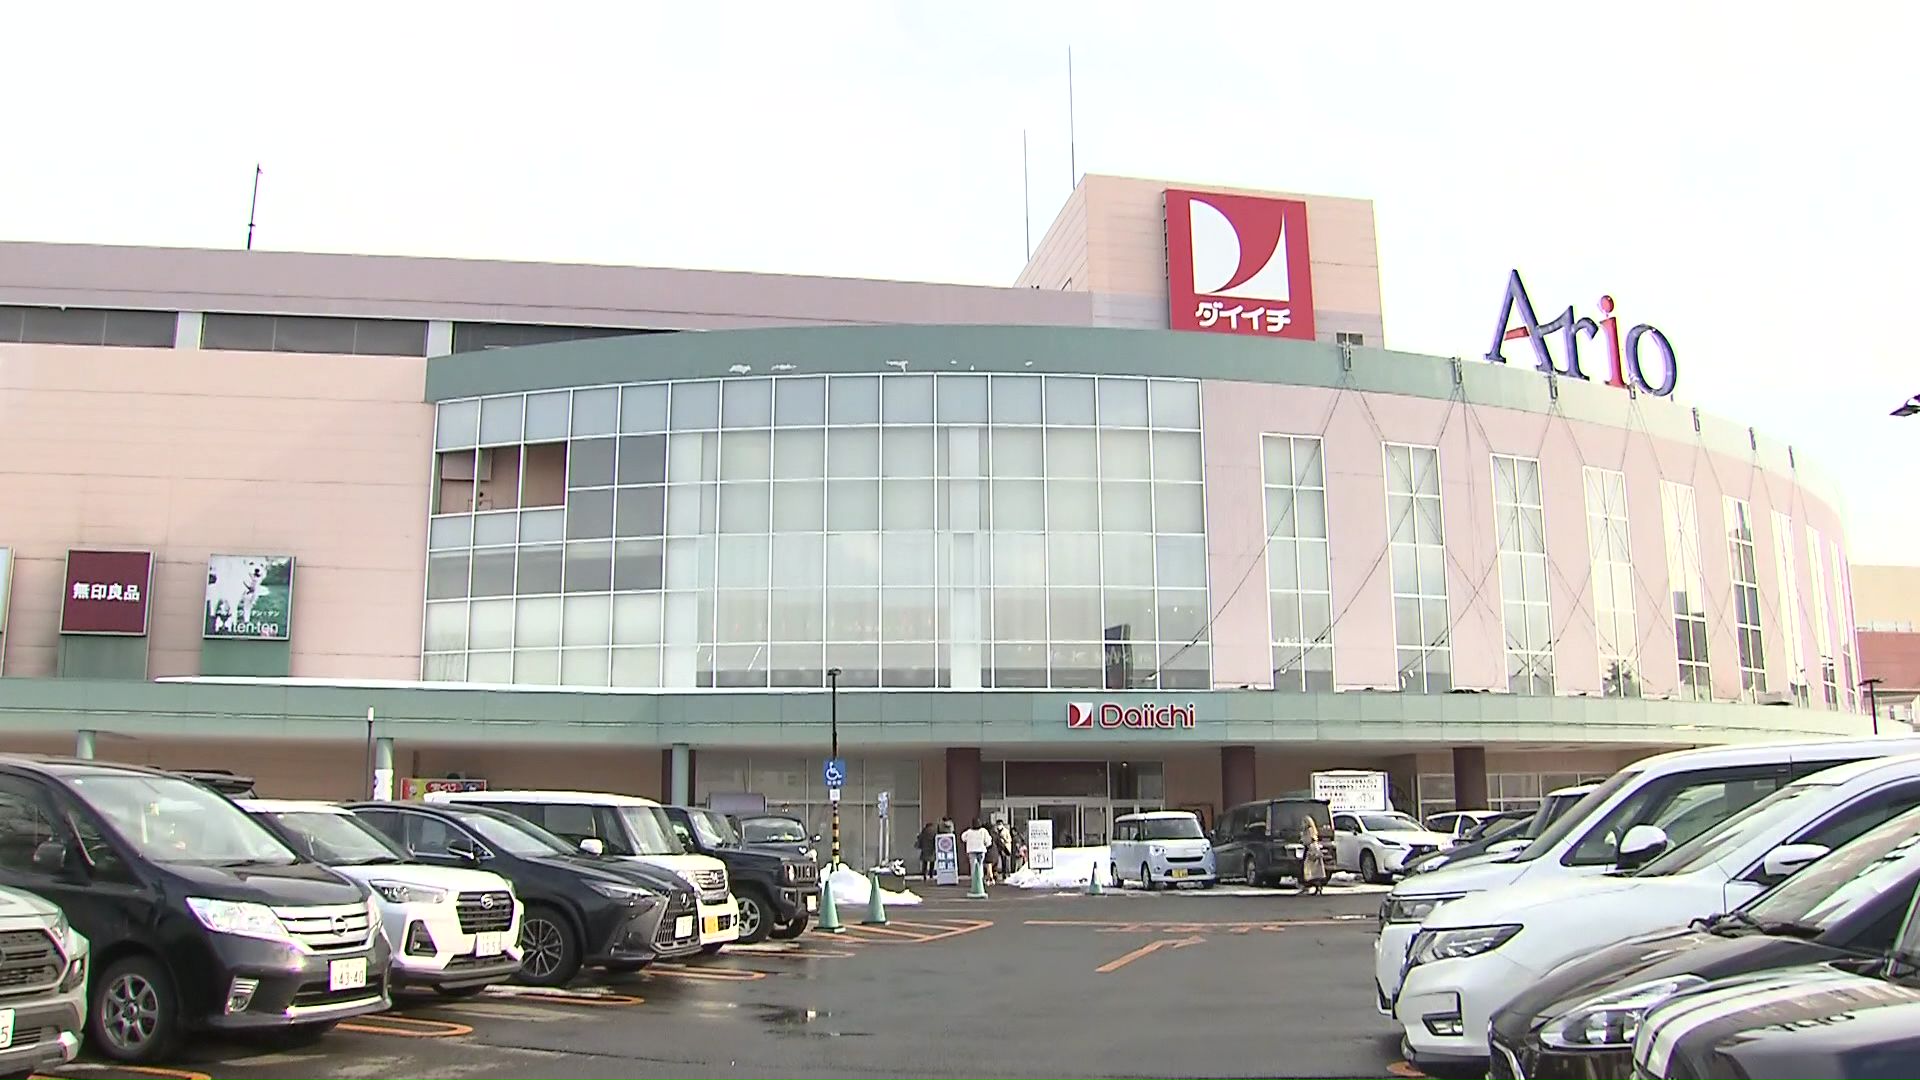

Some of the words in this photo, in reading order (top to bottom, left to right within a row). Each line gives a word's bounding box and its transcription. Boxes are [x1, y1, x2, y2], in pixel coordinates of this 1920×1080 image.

[1195, 301, 1291, 333] ダイイチ
[1484, 268, 1677, 397] Ario
[73, 582, 140, 601] 無印良品
[1100, 702, 1195, 728] Daiichi
